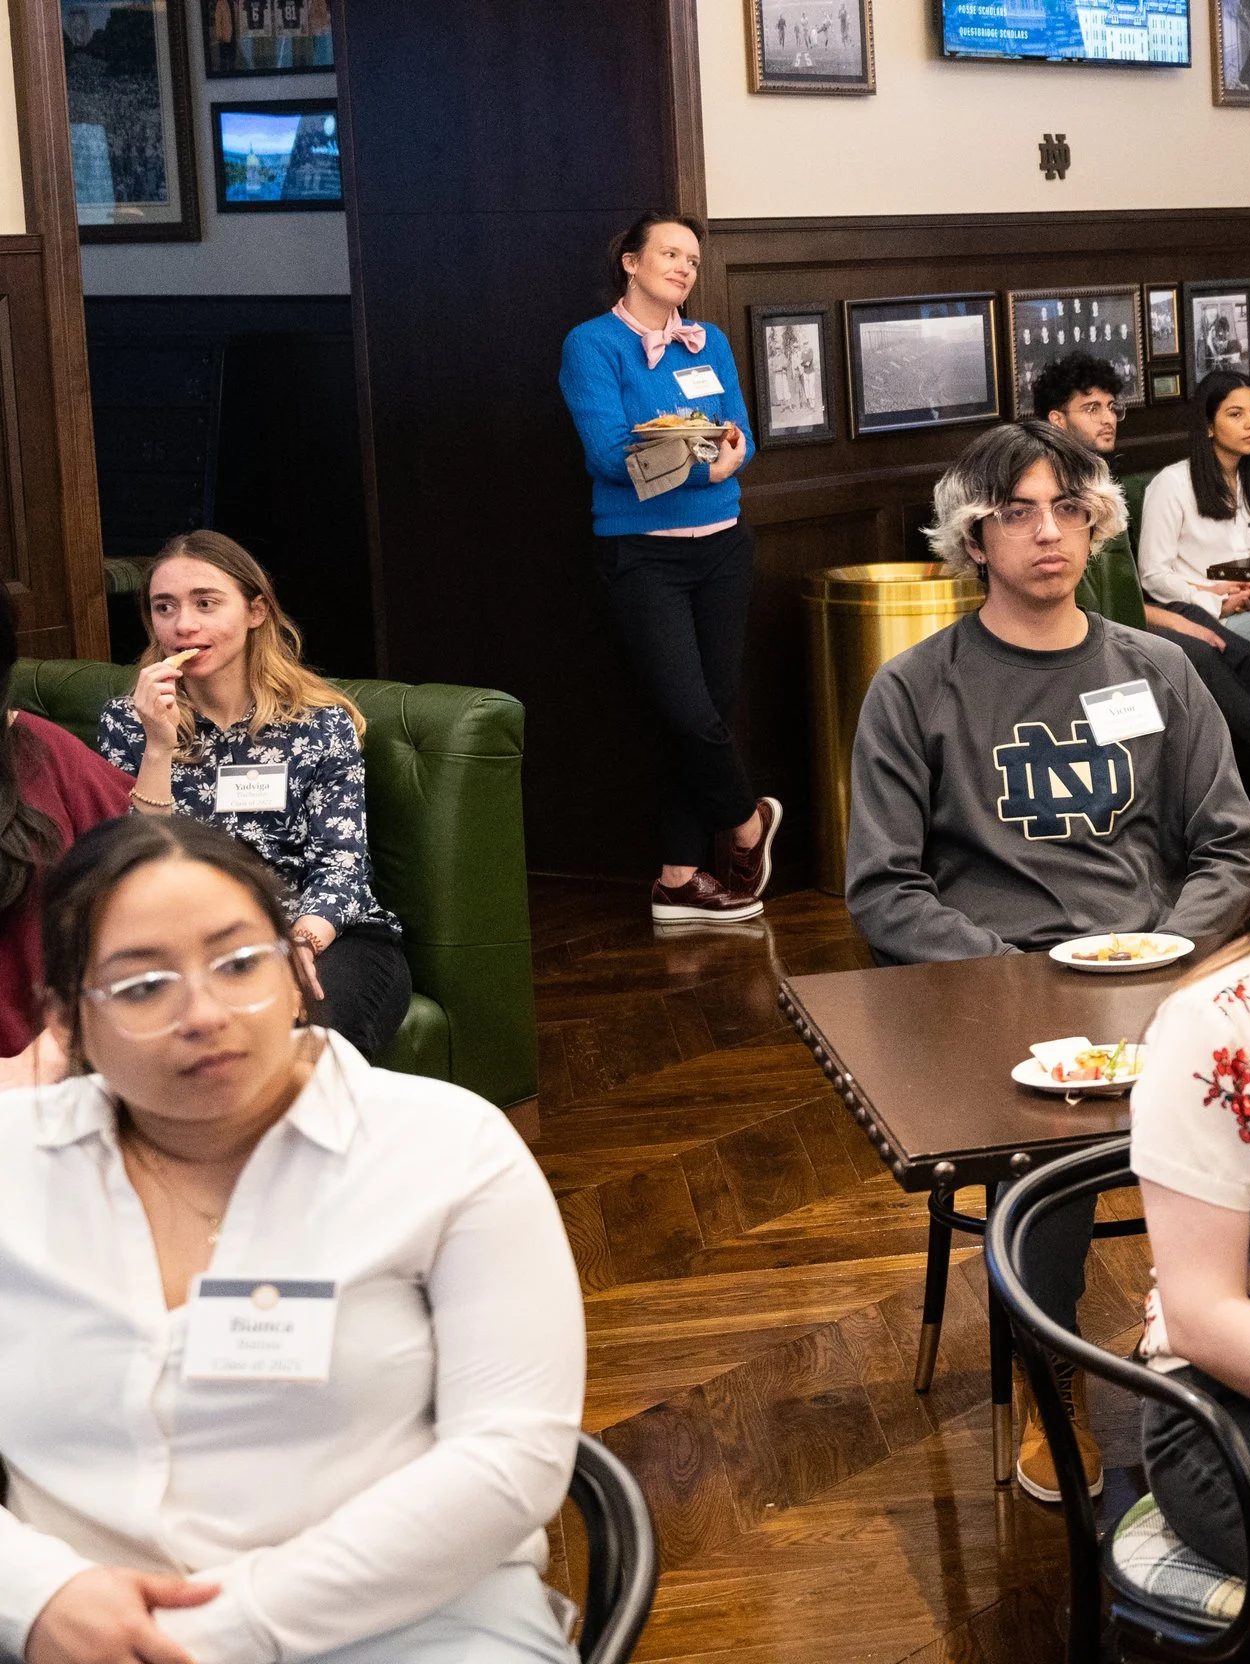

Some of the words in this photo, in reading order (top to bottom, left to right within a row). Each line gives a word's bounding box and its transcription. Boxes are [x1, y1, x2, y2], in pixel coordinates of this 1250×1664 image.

[958, 5, 976, 15] POSSE
[978, 6, 1007, 16] SCHOLARS
[959, 26, 998, 37] QUESTBRIDGE
[999, 29, 1028, 39] SCHOLARS
[1108, 705, 1137, 716] Victor
[234, 781, 271, 792] Yadviga
